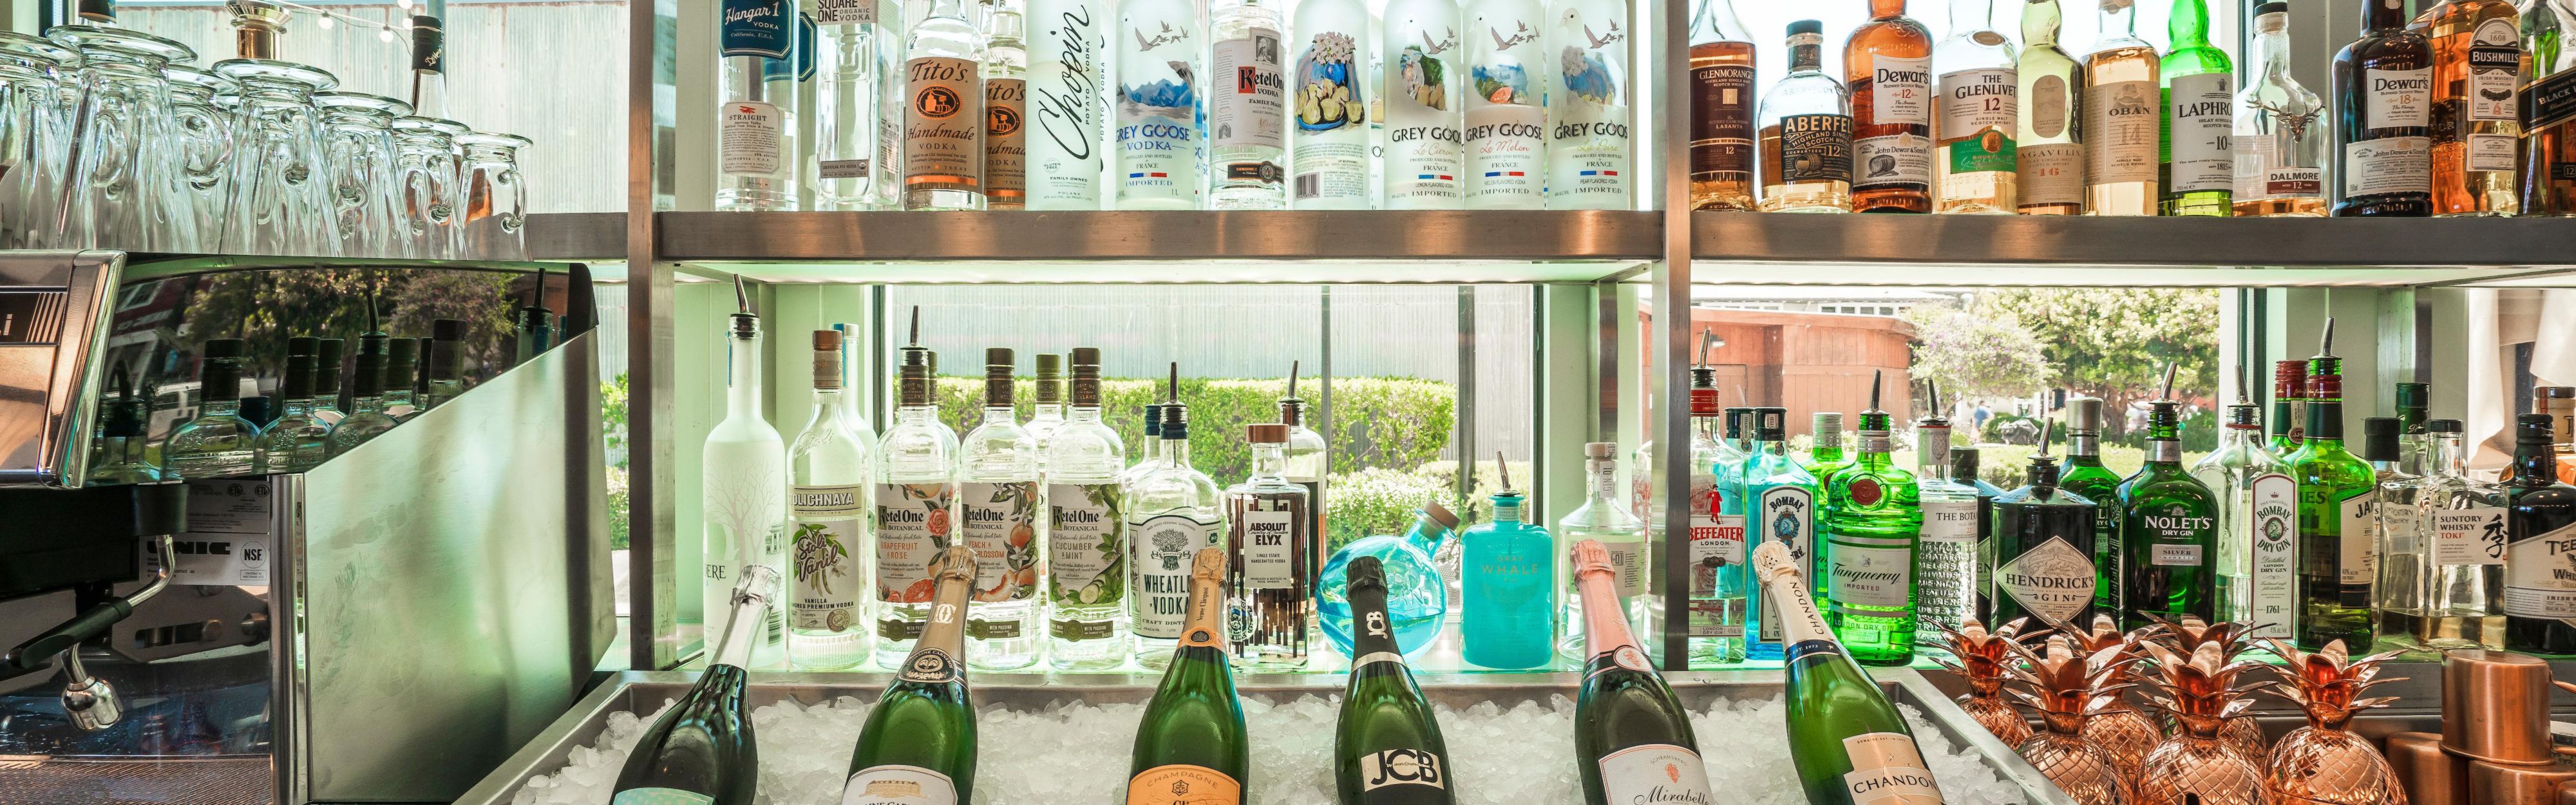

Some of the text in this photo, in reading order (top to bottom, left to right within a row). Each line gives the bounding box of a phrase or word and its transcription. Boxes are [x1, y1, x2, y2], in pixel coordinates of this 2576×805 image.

[818, 0, 857, 10] SQUARE
[725, 1, 779, 25] Hangar 1
[818, 10, 837, 22] ONE
[753, 21, 779, 30] VODKA
[2473, 52, 2519, 63] BUSHMILLS
[912, 60, 968, 82] Tito's
[1700, 70, 1754, 80] GLENMORANGIE
[1877, 69, 1928, 84] Dewar's
[1039, 5, 1097, 160] Chopin
[1240, 68, 1272, 91] Ketel
[1982, 75, 2002, 83] THE
[2374, 77, 2428, 91] Dewar's
[1257, 89, 1278, 97] VODKA
[1902, 90, 1911, 98] 12
[1955, 84, 2017, 99] GLENLIVET
[2538, 88, 2571, 104] BLACK
[1984, 98, 2000, 111] 12
[2400, 95, 2411, 104] 18
[2109, 108, 2150, 116] OBAN
[2179, 102, 2232, 118] LAPHRO
[907, 123, 974, 140] Handmade
[1117, 122, 1189, 142] GREY GOOSE
[1466, 120, 1542, 142] GREY GOOSE
[1555, 120, 1627, 140] GREY GOOS
[1785, 117, 1852, 133] ABERFEL
[1392, 124, 1461, 144] GREY GOOS
[1792, 131, 1830, 147] HIGHLAND
[2119, 124, 2142, 145] 14
[1127, 141, 1171, 151] VODKA
[1429, 143, 1454, 156] Citron
[1496, 140, 1530, 152] Melon
[1806, 137, 1833, 147] SCOTCH
[2217, 136, 2227, 150] 10
[1828, 146, 1841, 157] 12
[2270, 173, 2318, 181] DALMORE
[1603, 477, 1612, 491] GIN
[1769, 497, 1804, 512] BOMBAY
[878, 506, 924, 529] Ketel One
[983, 508, 1004, 522] One
[1052, 507, 1099, 528] Ketel One
[2257, 506, 2292, 521] BOMBAY
[2145, 515, 2210, 529] NOLET'S
[1256, 535, 1282, 545] ELYX
[1689, 527, 1744, 542] BEEFEATER
[797, 533, 827, 559] Stoli
[1056, 542, 1092, 550] CUCUMBER
[2257, 539, 2291, 553] DRY GIN
[244, 549, 262, 561] NSF
[796, 544, 838, 582] Vanil
[1482, 564, 1538, 575] WHALE
[1833, 563, 1900, 585] Tanqueray
[2006, 574, 2094, 589] HENDRICK'S
[1844, 583, 1879, 591] IMPORTED
[1199, 587, 1208, 609] Clicquot
[1790, 582, 1824, 635] CHANDON
[2266, 605, 2280, 614] 1761
[1365, 611, 1388, 639] JCB
[1835, 619, 1861, 629] LONDON
[932, 651, 953, 668] CARNEROS
[1370, 749, 1438, 785] JCB
[1147, 772, 1218, 789] CHAMPAGNE
[1853, 775, 1937, 793] CHANDON
